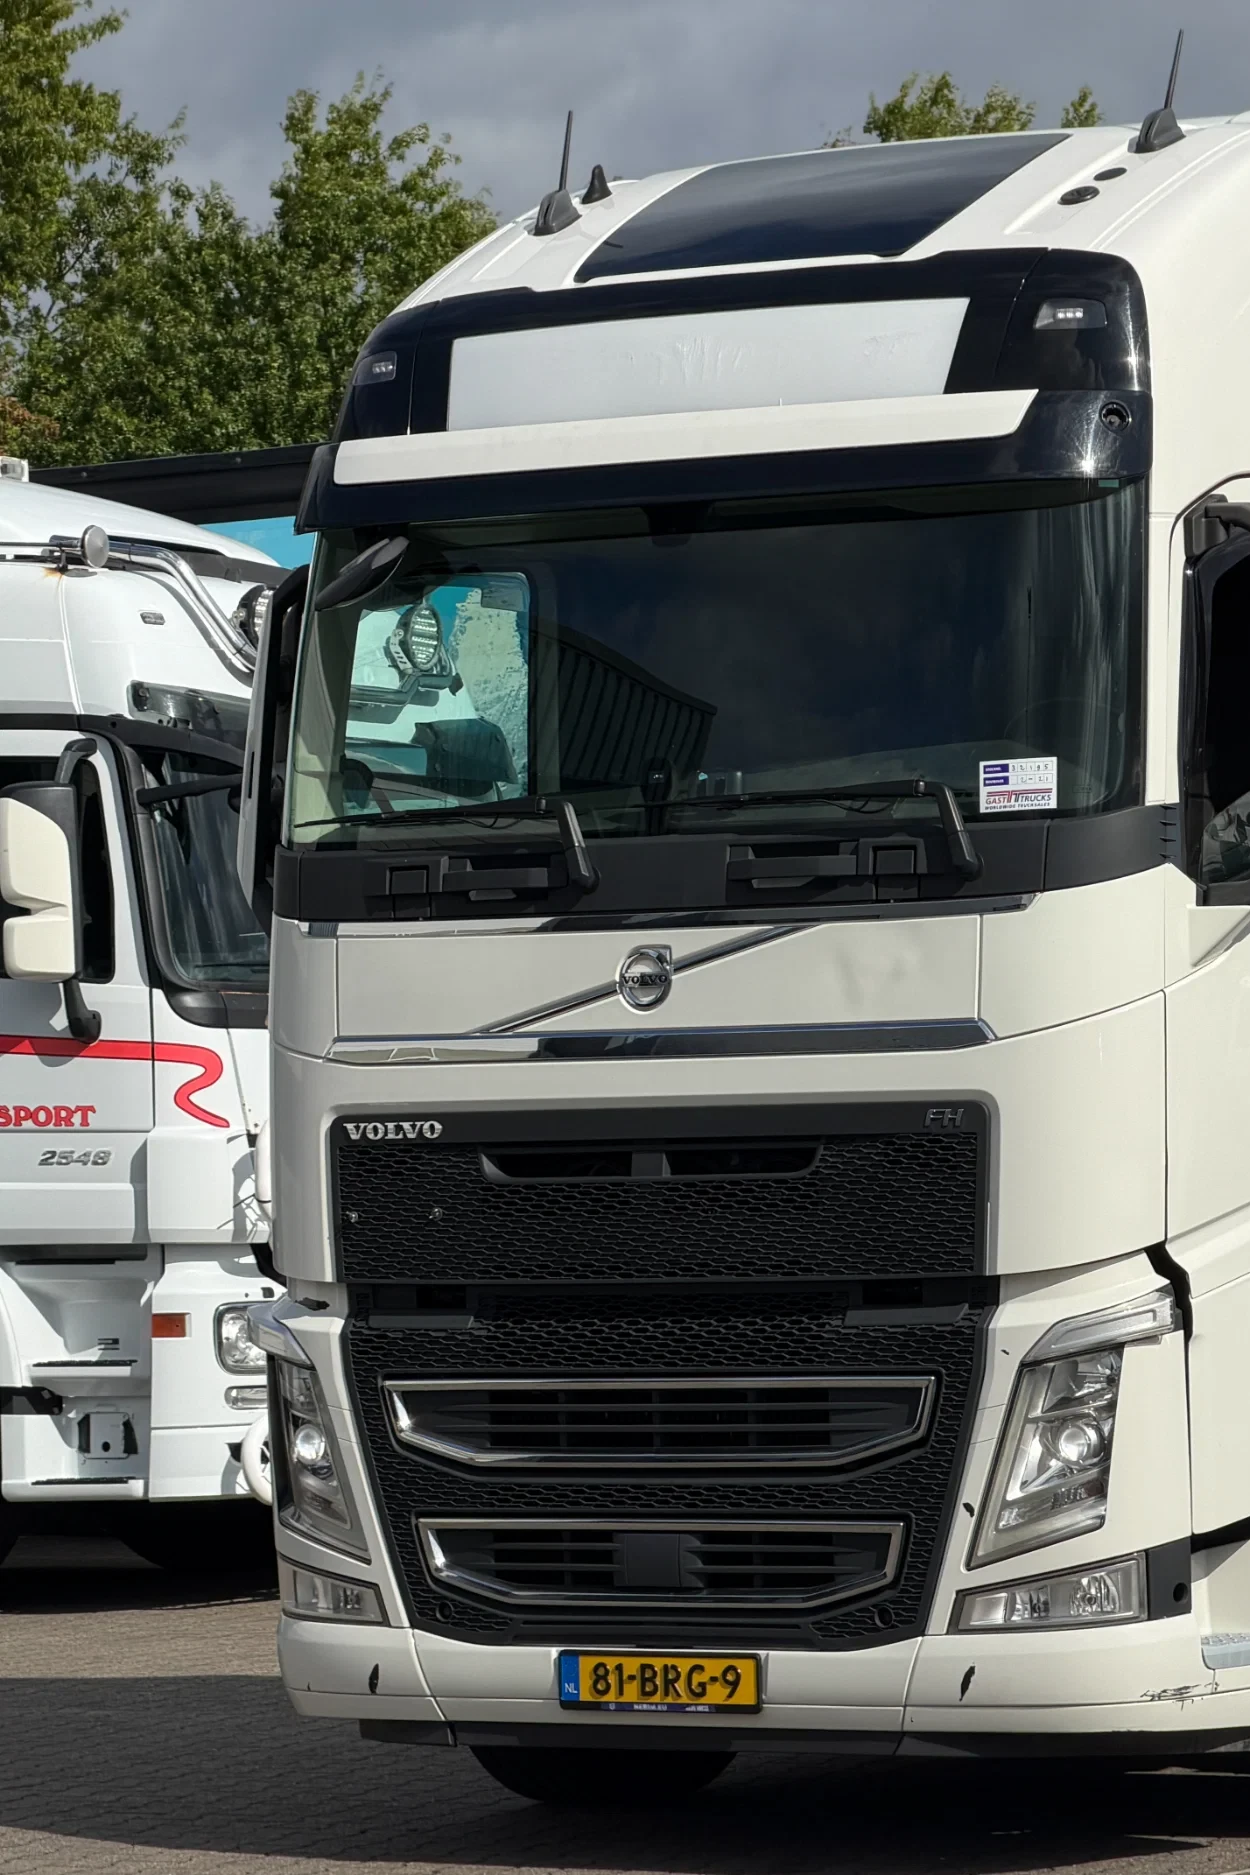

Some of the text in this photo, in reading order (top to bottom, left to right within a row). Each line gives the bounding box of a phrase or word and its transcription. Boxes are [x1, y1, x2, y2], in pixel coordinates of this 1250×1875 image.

[622, 974, 668, 985] VOLVO
[0, 1104, 97, 1128] SPORT
[924, 1108, 965, 1127] FH
[343, 1121, 443, 1140] VOLVO
[564, 1662, 743, 1699] NL 81-BRG-9
